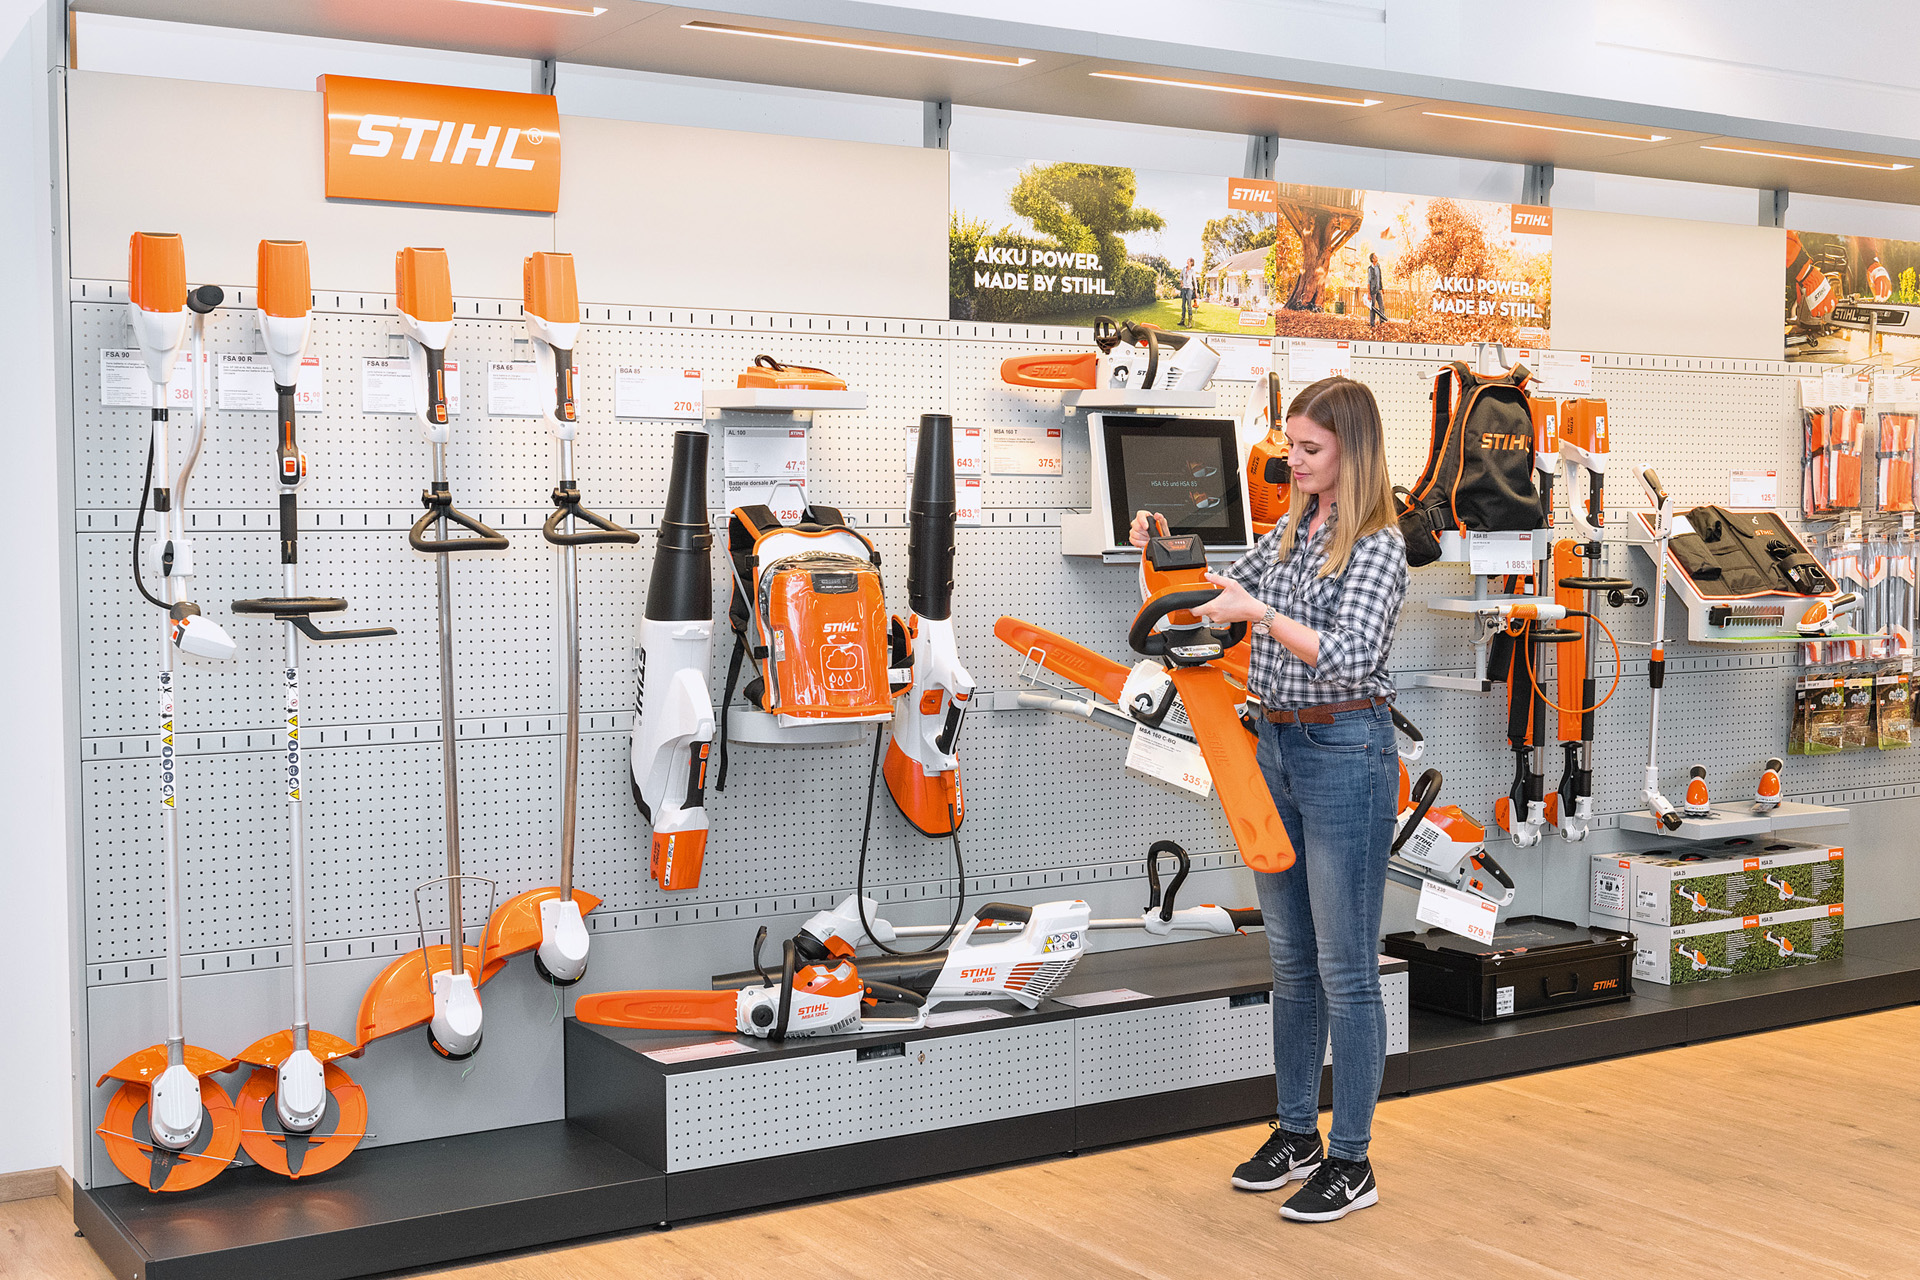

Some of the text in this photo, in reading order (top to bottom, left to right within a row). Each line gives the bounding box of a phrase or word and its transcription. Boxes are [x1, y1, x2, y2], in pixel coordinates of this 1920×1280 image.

[974, 246, 1103, 271] AKKU POWER.
[974, 271, 1116, 295] MADE BY STIHL.
[1433, 276, 1533, 296] AKKU POWER.
[1432, 298, 1543, 318] MADE BY STIHL.
[1833, 308, 1857, 322] STIHL
[1031, 366, 1068, 377] STIHL
[823, 622, 858, 632] STIHL
[636, 643, 646, 716] STIHL
[1138, 726, 1151, 736] MSA
[1414, 834, 1433, 848] STIHL
[1426, 882, 1437, 891] TSA
[960, 967, 996, 979] STIHL
[1592, 979, 1618, 991] STIHL
[798, 1002, 828, 1016] STIHL
